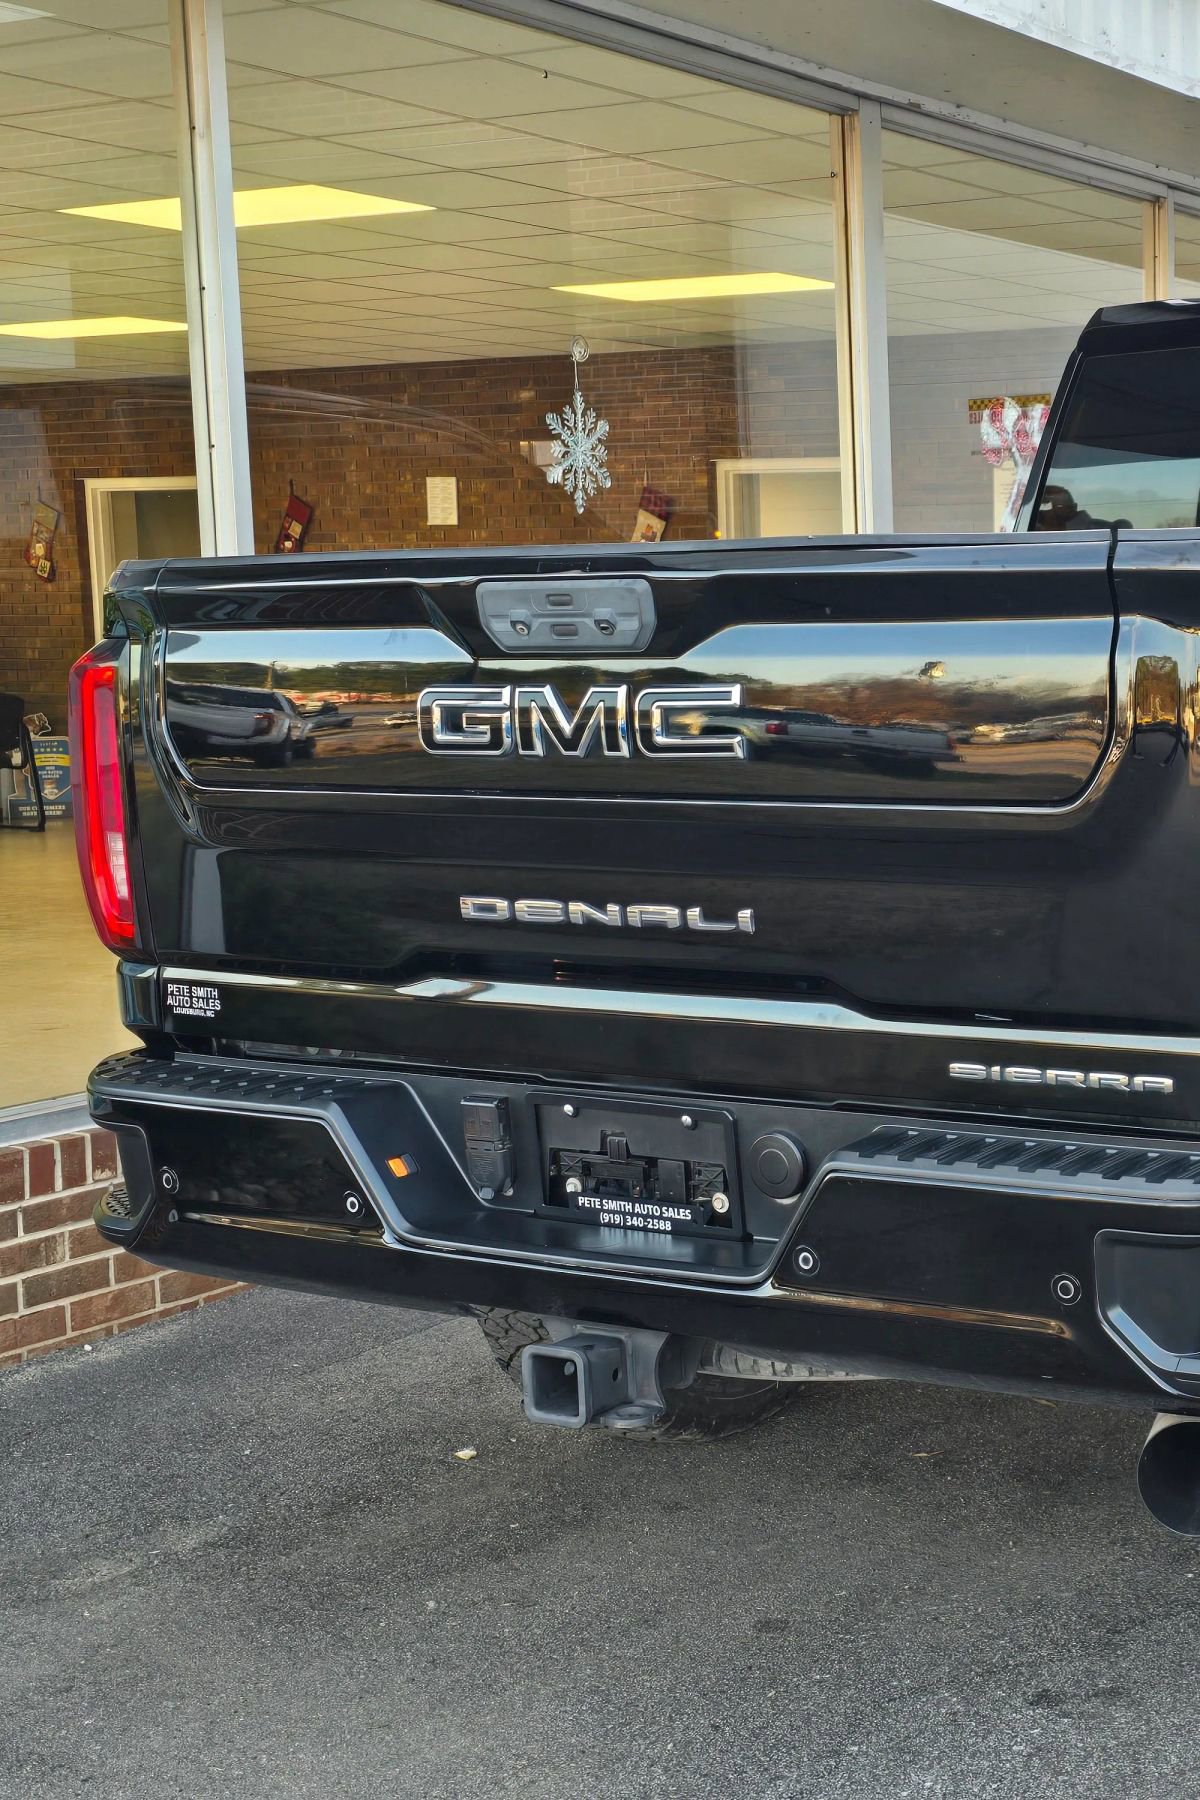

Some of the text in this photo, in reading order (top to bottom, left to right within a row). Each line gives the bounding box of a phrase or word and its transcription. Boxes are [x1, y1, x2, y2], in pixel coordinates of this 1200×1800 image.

[418, 684, 747, 760] GMC
[459, 895, 756, 935] DENALI
[166, 995, 221, 1010] AUTO SALES
[167, 983, 219, 999] PETE SMITH
[948, 1062, 1174, 1095] SIERRA
[578, 1196, 692, 1220] PETE SMITH AUTO SALES
[600, 1211, 672, 1231] (919) 340-2588
